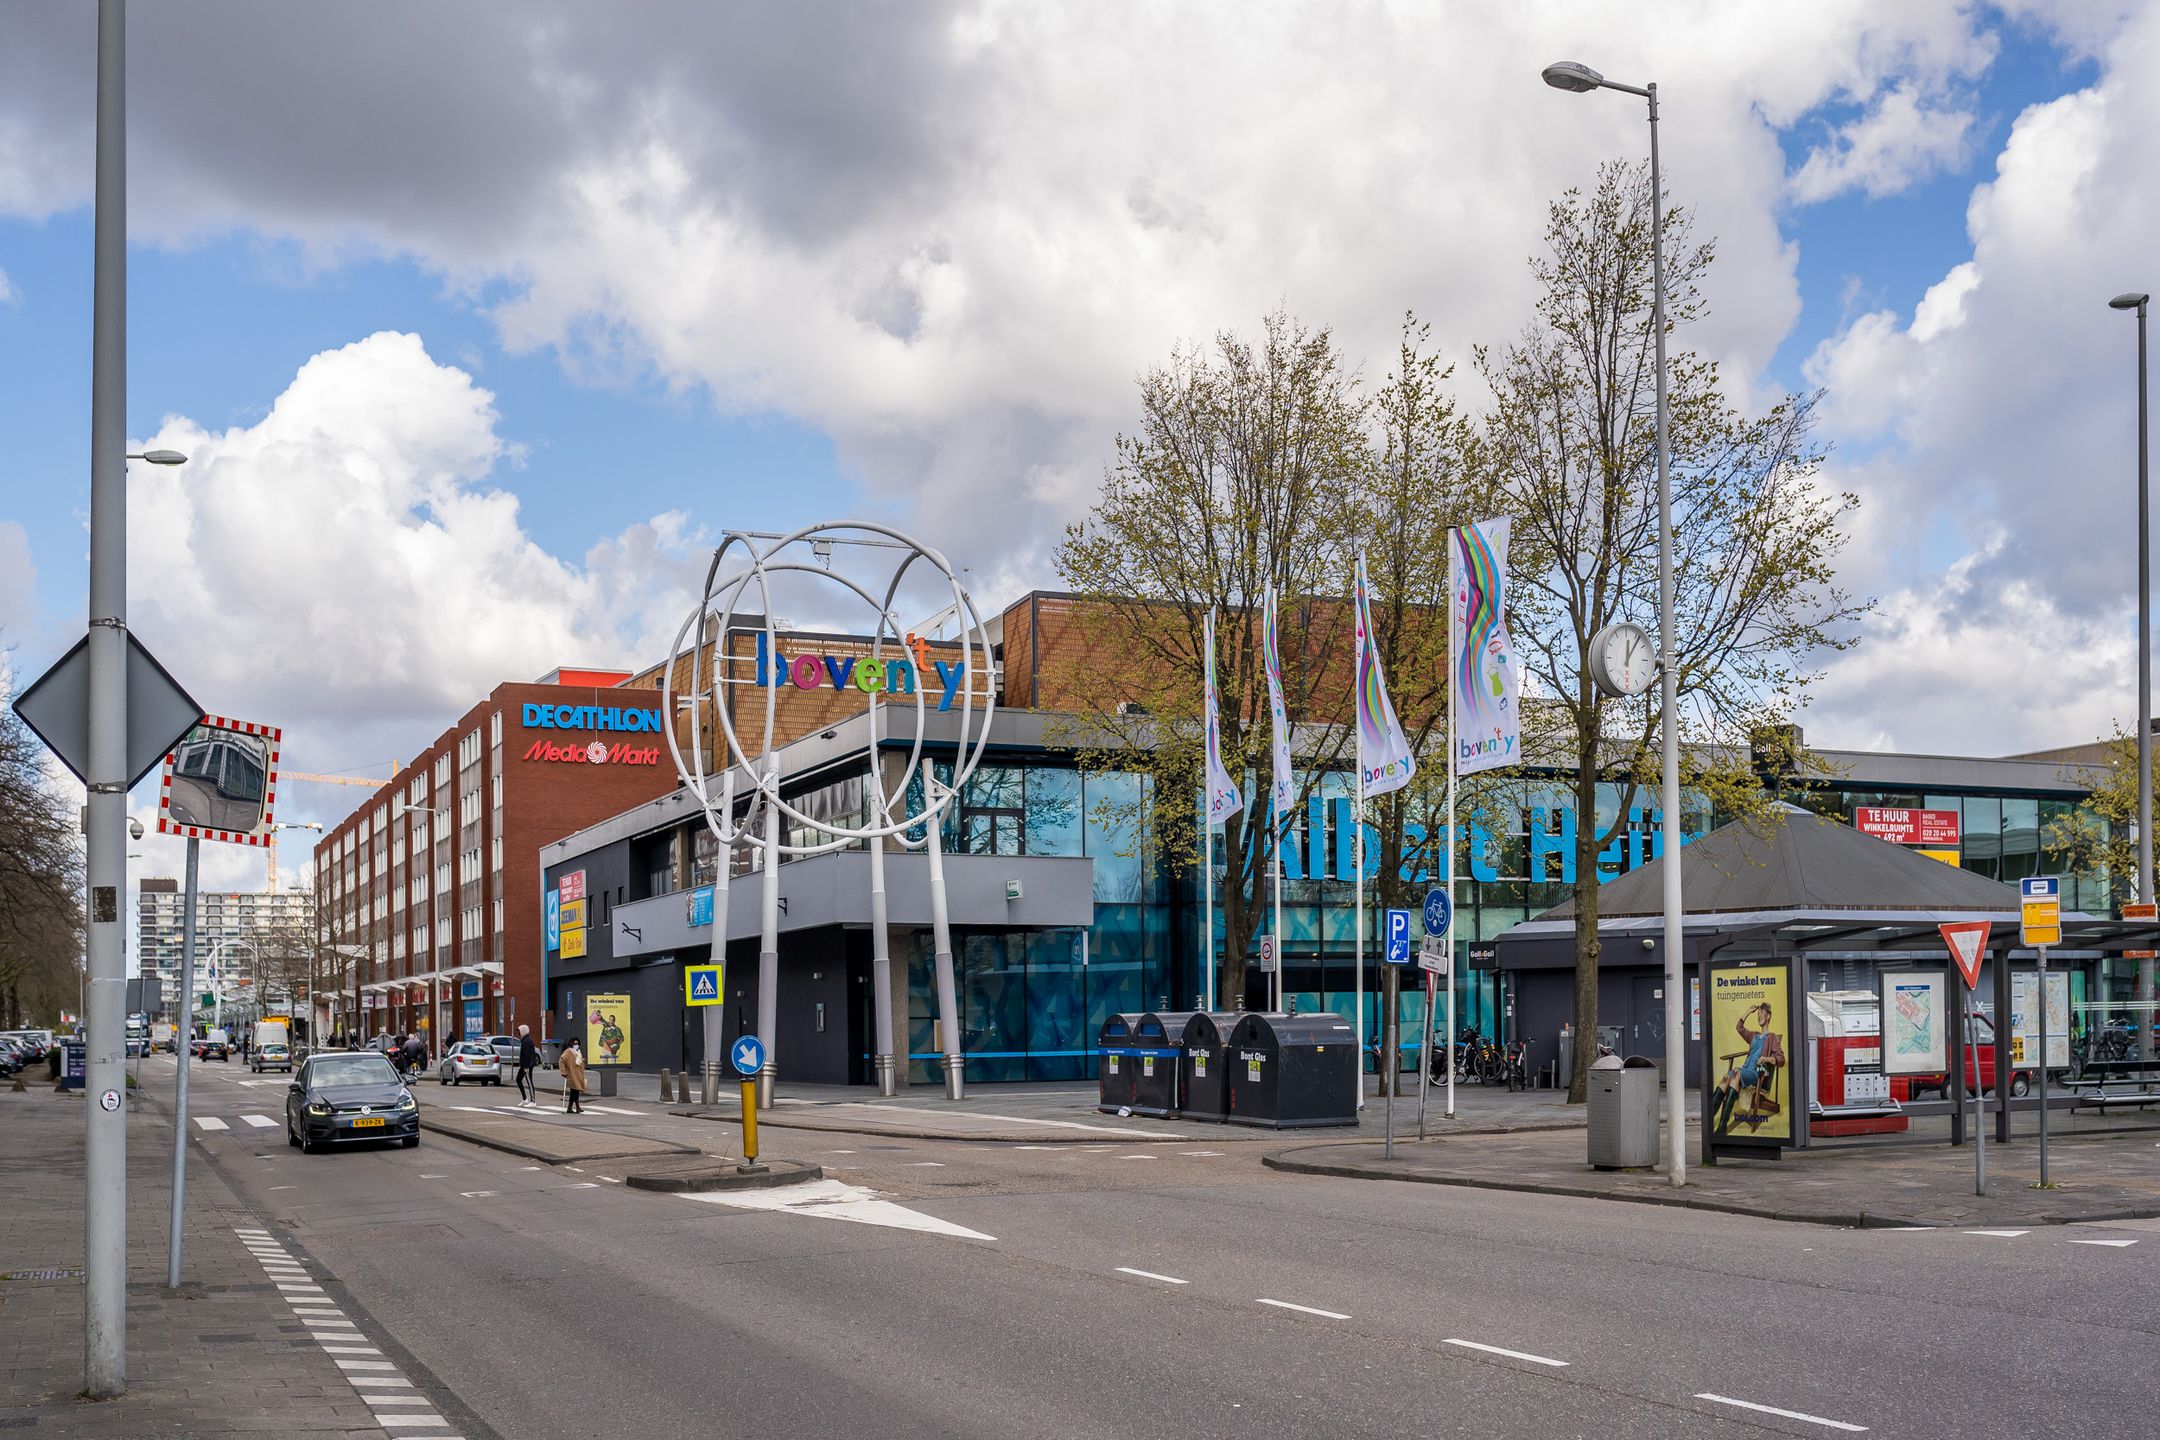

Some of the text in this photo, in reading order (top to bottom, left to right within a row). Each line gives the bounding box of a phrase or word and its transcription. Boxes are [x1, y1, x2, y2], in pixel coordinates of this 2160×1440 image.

[522, 703, 661, 733] DECATHLON
[523, 739, 661, 766] Media Markt
[1867, 809, 1910, 823] TE HUUR
[1863, 823, 1914, 833] WINKELRUIMTE
[1922, 829, 1932, 837] 020
[1393, 914, 1405, 941] P
[1717, 975, 1777, 987] De winkel van
[1717, 990, 1766, 1001] tuingenieters
[1240, 1051, 1266, 1062] Bont Glas
